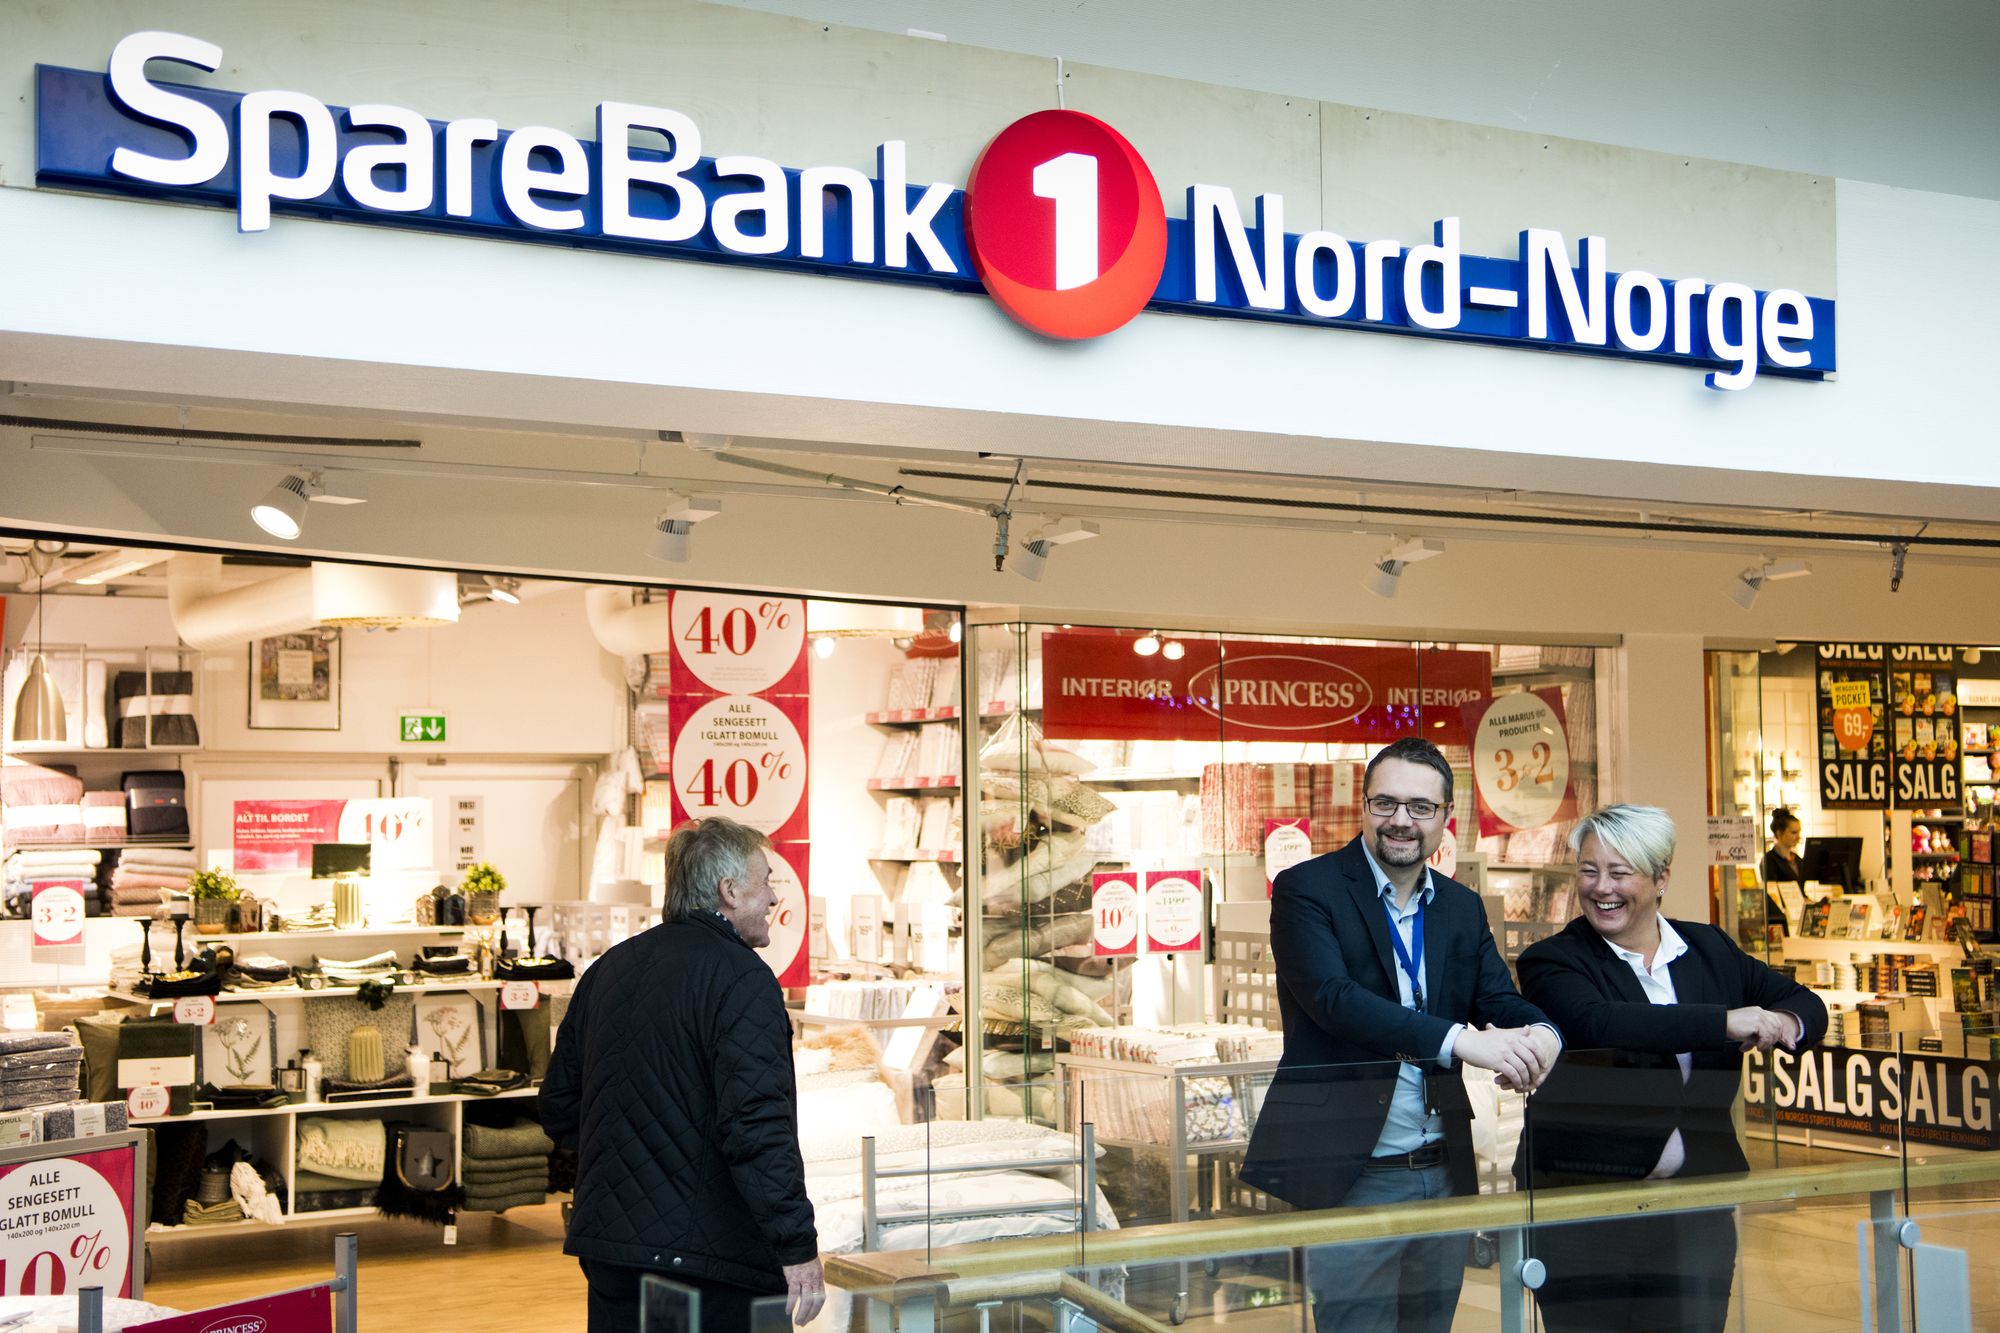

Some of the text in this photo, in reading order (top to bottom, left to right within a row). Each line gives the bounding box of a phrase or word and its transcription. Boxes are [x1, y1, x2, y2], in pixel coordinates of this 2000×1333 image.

[108, 30, 1815, 391] SpareBank 1 Nord-Norge
[684, 601, 791, 656] 40%
[1061, 677, 1173, 699] INTERIØR
[1224, 679, 1356, 708] PRINCESS
[1836, 693, 1867, 705] POCKET
[729, 704, 751, 713] ALLE
[1489, 714, 1506, 727] ALLE
[1508, 711, 1535, 723] MARIUS
[713, 718, 767, 727] SENGESETT
[1499, 723, 1541, 738] PRODUKTER
[706, 731, 736, 740] GLATT
[739, 731, 779, 740] BOMULL
[1494, 748, 1519, 792] 3
[1532, 741, 1554, 785] 2
[686, 751, 792, 808] 40%
[1825, 763, 1885, 800] SALG
[1898, 763, 1956, 800] SALG
[255, 813, 269, 823] TIL
[271, 813, 309, 823] BORDET
[1773, 1047, 1873, 1118] SALG
[1879, 1056, 1992, 1132] SALG
[0, 1117, 22, 1126] OMULL
[29, 1171, 61, 1187] ALLE
[8, 1186, 81, 1210] SENGESETT
[0, 1204, 96, 1231] GLATT BOMULL
[7, 1221, 81, 1240] 140x200 og 140x220 cm
[0, 1229, 111, 1296] 0%
